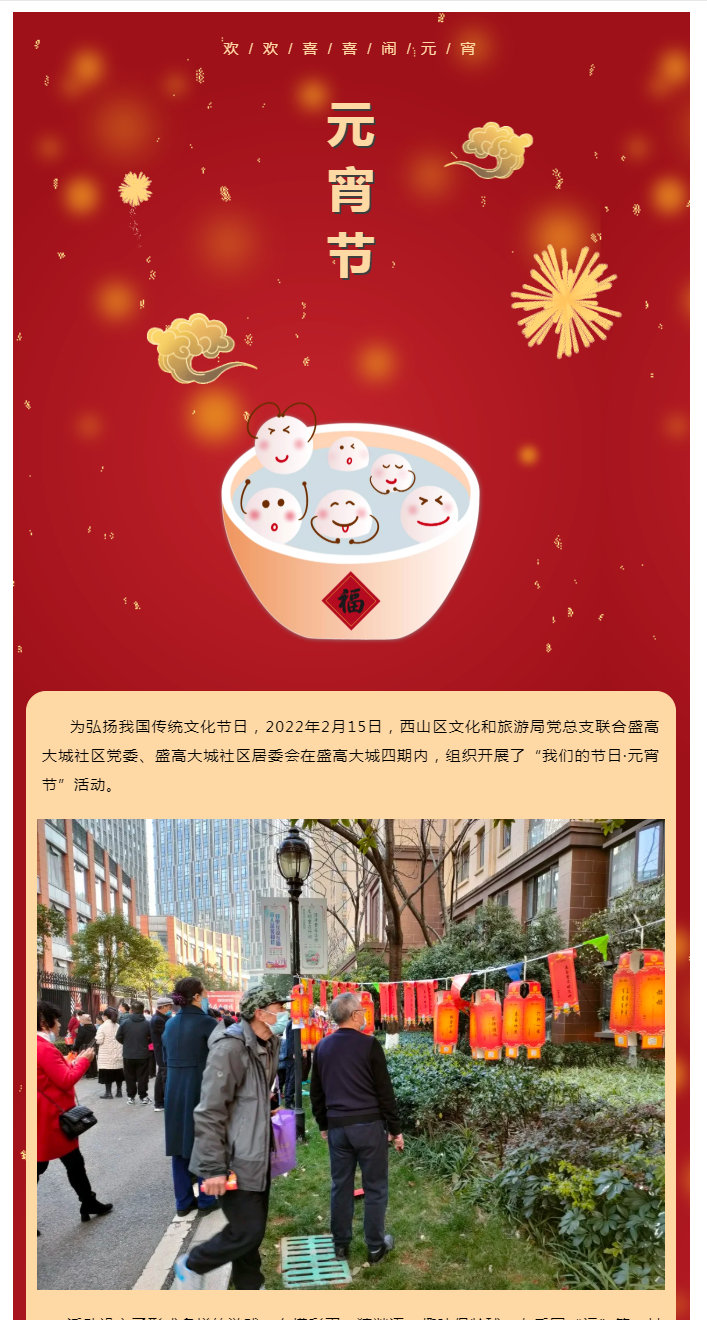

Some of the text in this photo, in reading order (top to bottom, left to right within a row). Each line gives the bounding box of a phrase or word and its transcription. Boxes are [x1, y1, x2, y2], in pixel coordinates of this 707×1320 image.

[327, 102, 375, 279] 元宵节
[338, 588, 365, 614] 福
